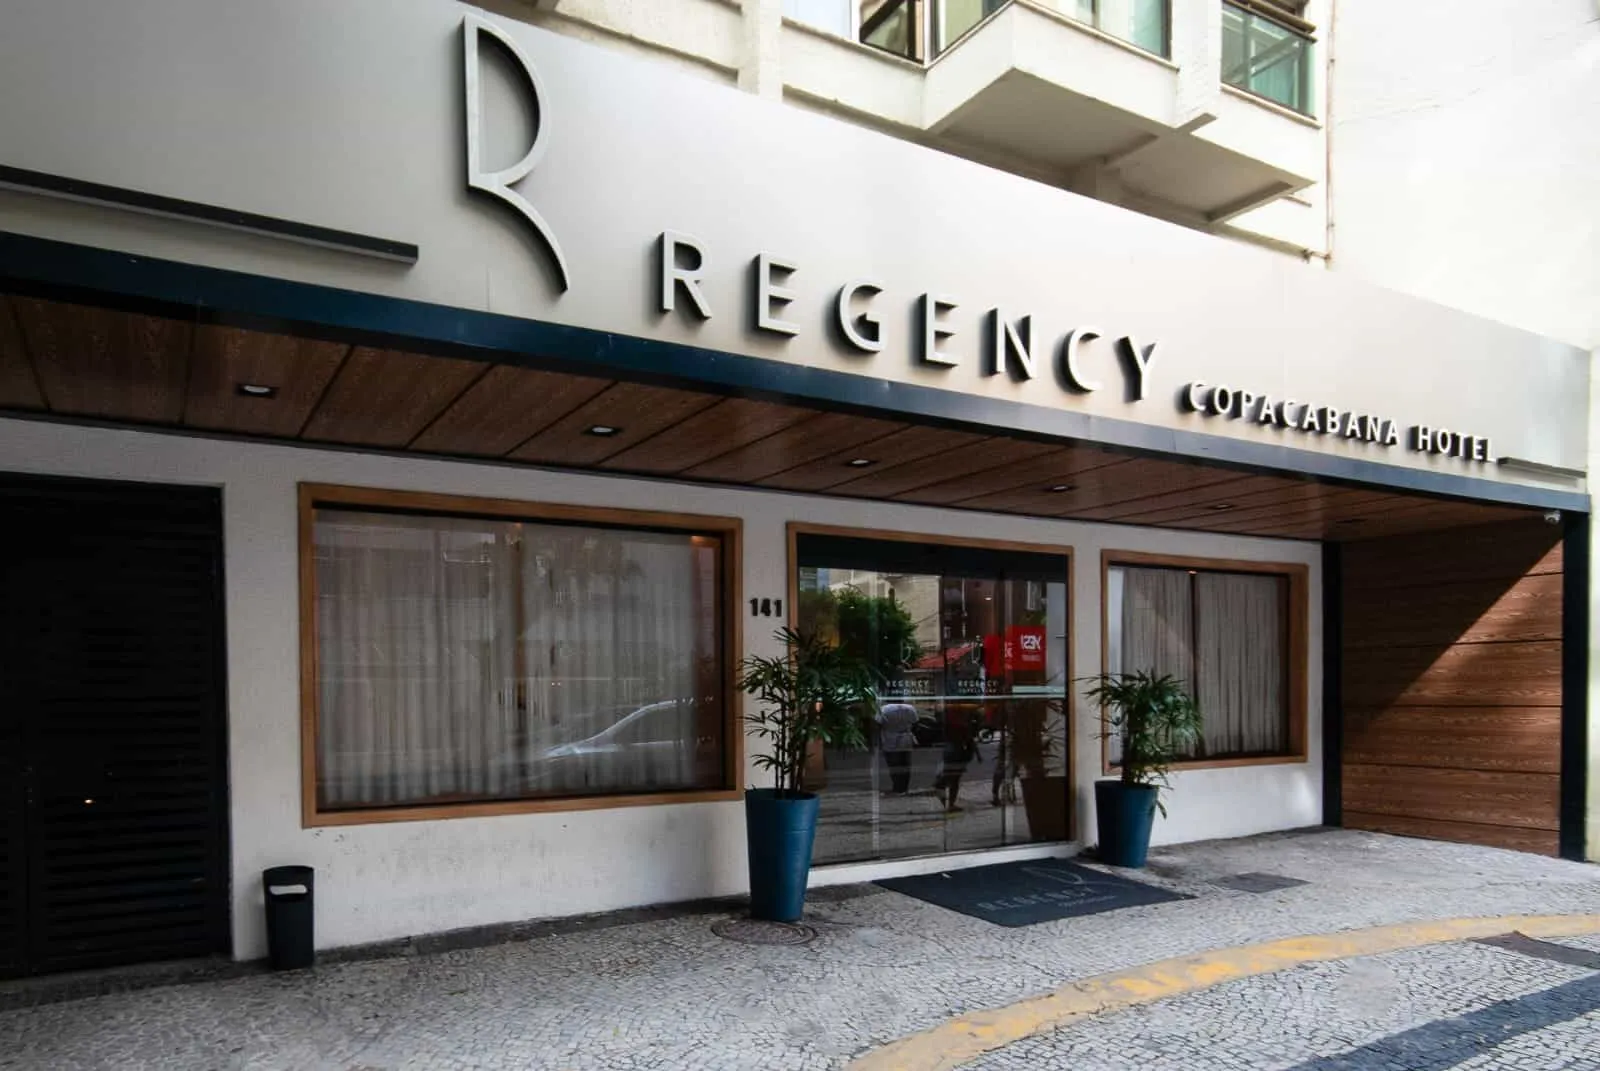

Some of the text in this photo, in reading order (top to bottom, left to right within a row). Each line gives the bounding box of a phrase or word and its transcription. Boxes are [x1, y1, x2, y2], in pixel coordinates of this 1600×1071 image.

[656, 229, 1496, 462] REGENCY COPACABANA HOTEL
[750, 598, 782, 617] 141
